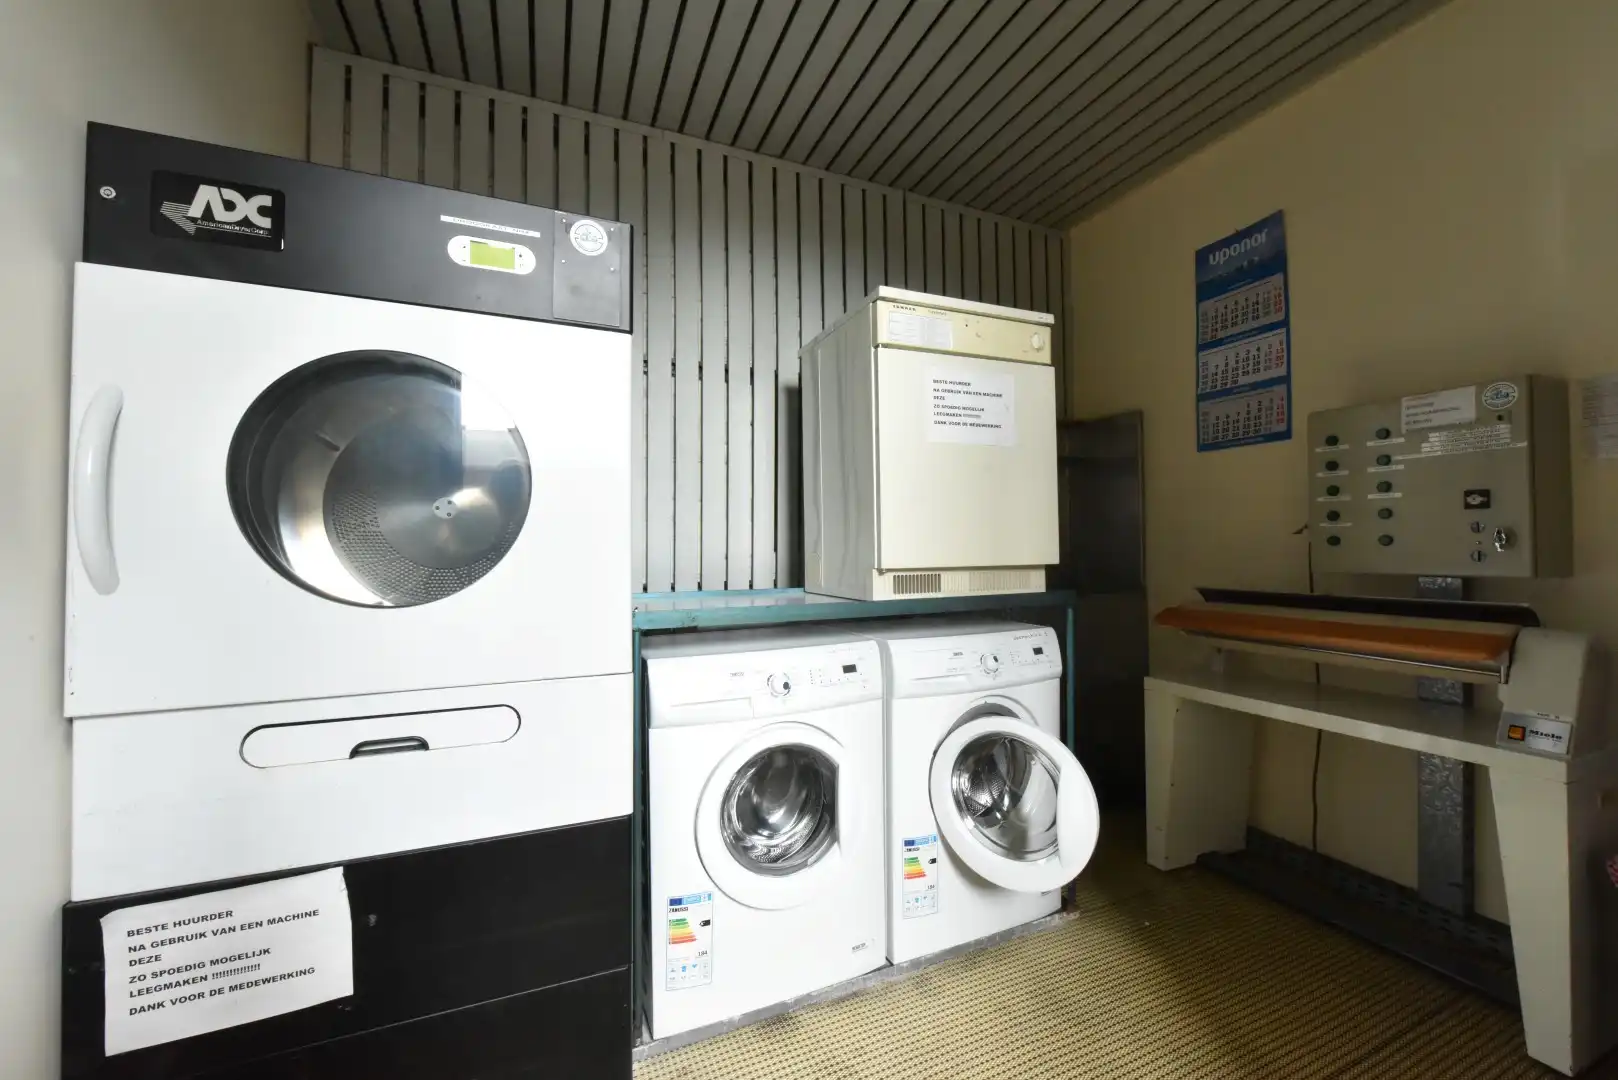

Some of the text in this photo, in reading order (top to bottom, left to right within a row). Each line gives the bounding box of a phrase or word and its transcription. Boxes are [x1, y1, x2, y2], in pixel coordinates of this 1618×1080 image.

[187, 184, 272, 228] ADC
[1209, 228, 1268, 264] uponor
[1529, 730, 1562, 739] Miele
[127, 910, 235, 938] BESTE HUURDER
[128, 909, 320, 953] NA GEBRUIK VAN EEN MACHINE
[129, 954, 162, 967] DEZE
[129, 948, 272, 983] ZO SPOEDIG MOGELIJK
[129, 974, 208, 998] LEEGMAKEN
[129, 967, 316, 1016] DANK VOOR DE MEDEWERKING
